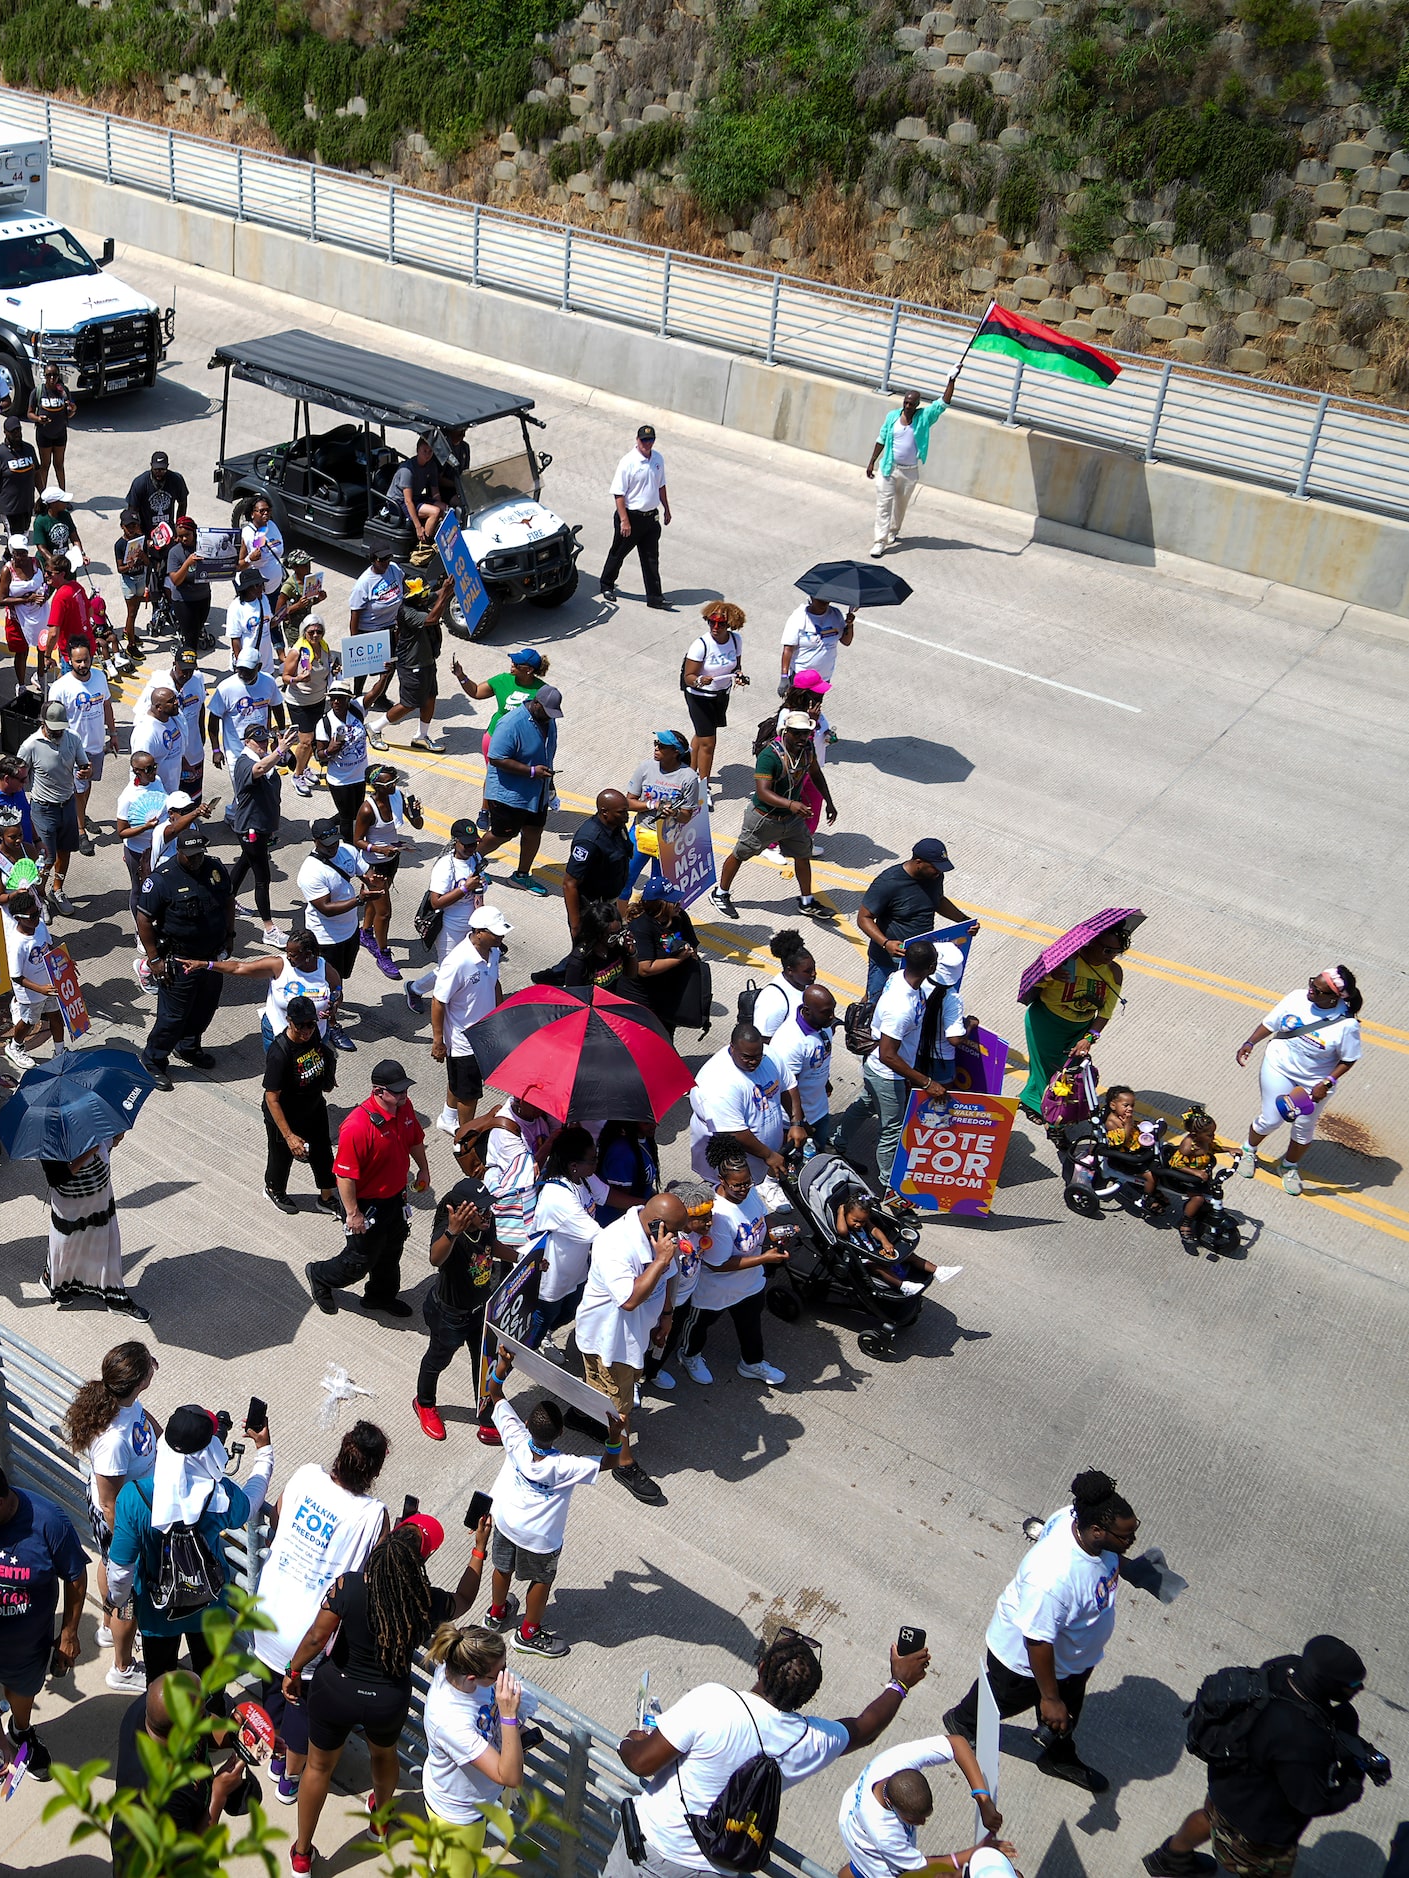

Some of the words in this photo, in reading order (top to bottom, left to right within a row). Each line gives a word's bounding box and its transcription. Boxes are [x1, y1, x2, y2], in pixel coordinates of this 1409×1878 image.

[12, 171, 23, 182] 44
[41, 398, 65, 408] BEN
[8, 456, 34, 471] BEN
[498, 513, 513, 526] FORT
[515, 507, 538, 520] WORTH
[526, 528, 546, 542] FIRE
[455, 556, 466, 577] GO
[463, 580, 481, 613] OPAL!
[348, 642, 383, 658] TCDP
[674, 828, 697, 856] GO
[674, 852, 712, 893] PAL!
[675, 848, 702, 880] MS.
[60, 980, 75, 1001] GO
[64, 1000, 85, 1023] VOTE
[952, 1103, 978, 1111] OPAL'S
[954, 1110, 976, 1118] WALK
[952, 1116, 992, 1126] FREEDOM
[914, 1128, 996, 1154] VOTE
[906, 1148, 990, 1178] FOR
[903, 1171, 983, 1189] FREEDOM
[304, 1496, 338, 1522] WALKIN
[294, 1504, 334, 1541] FOR
[292, 1522, 328, 1550] FREEDOM
